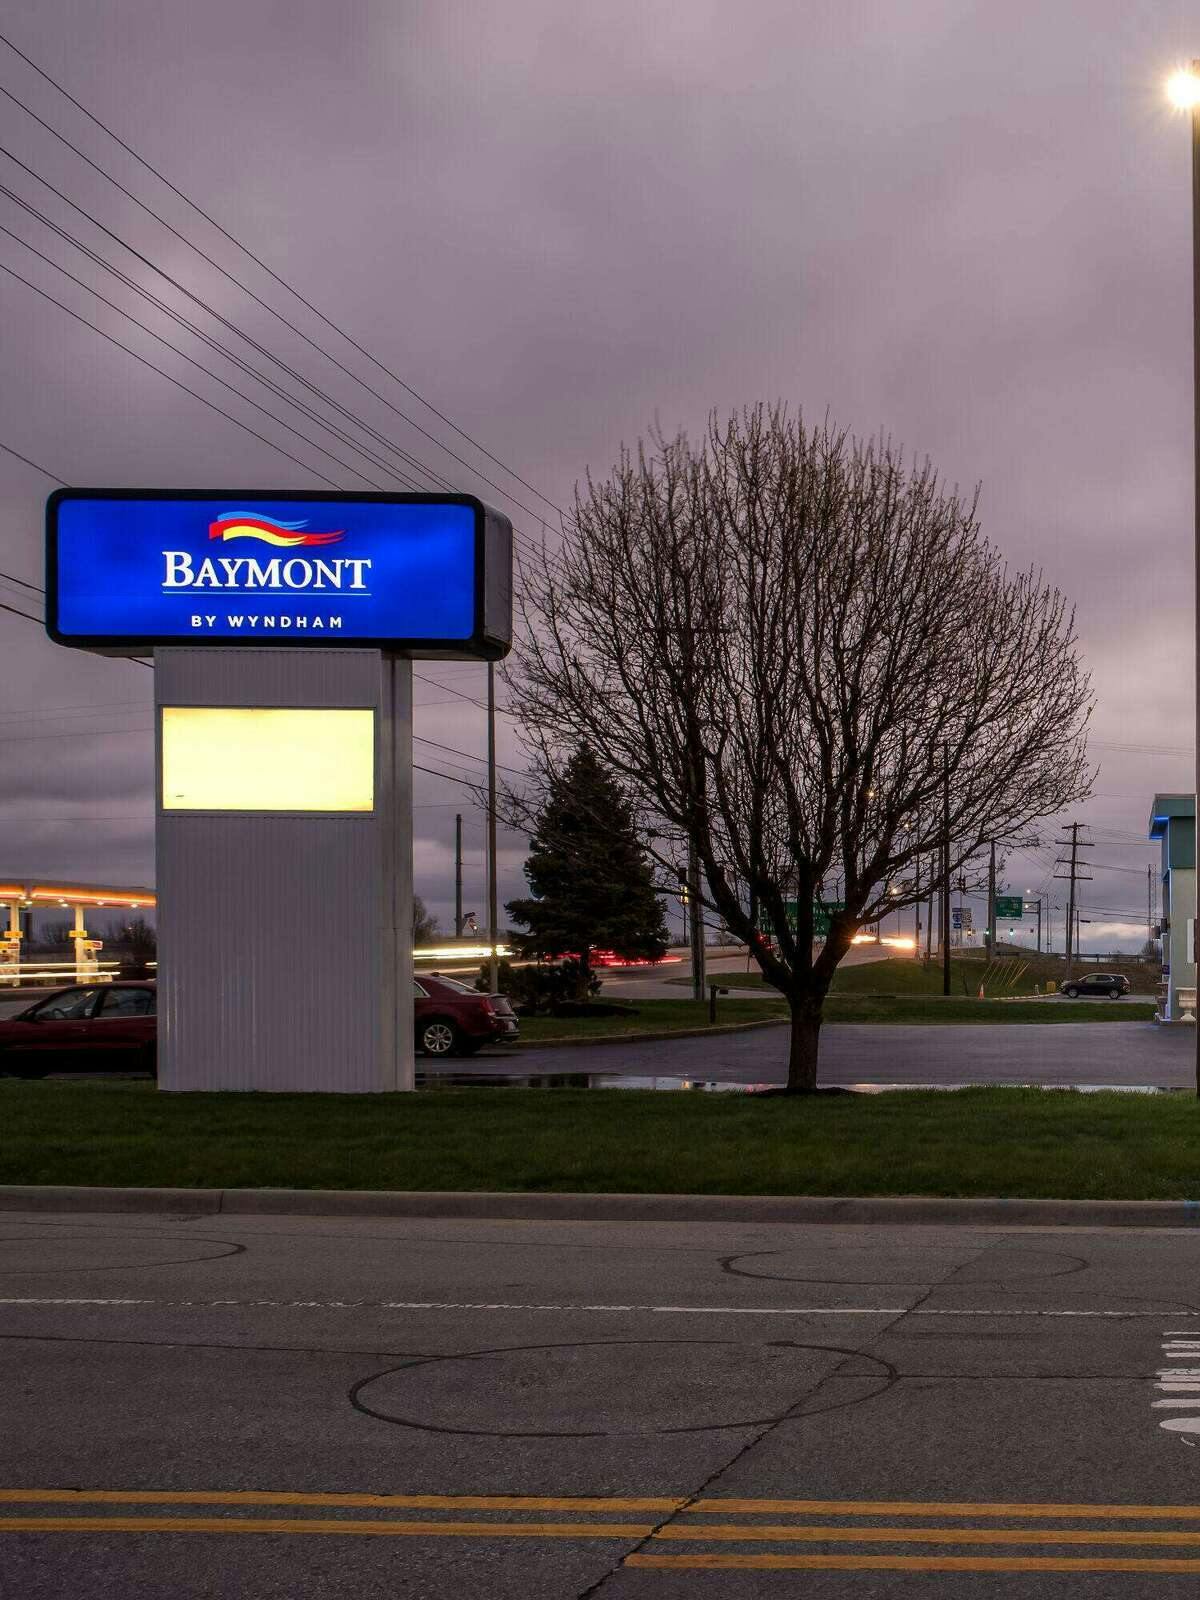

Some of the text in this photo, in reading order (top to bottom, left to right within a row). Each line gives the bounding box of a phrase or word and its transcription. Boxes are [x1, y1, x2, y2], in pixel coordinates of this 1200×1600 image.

[162, 551, 371, 588] BAYMONT
[191, 615, 343, 628] BY WYNDHAM
